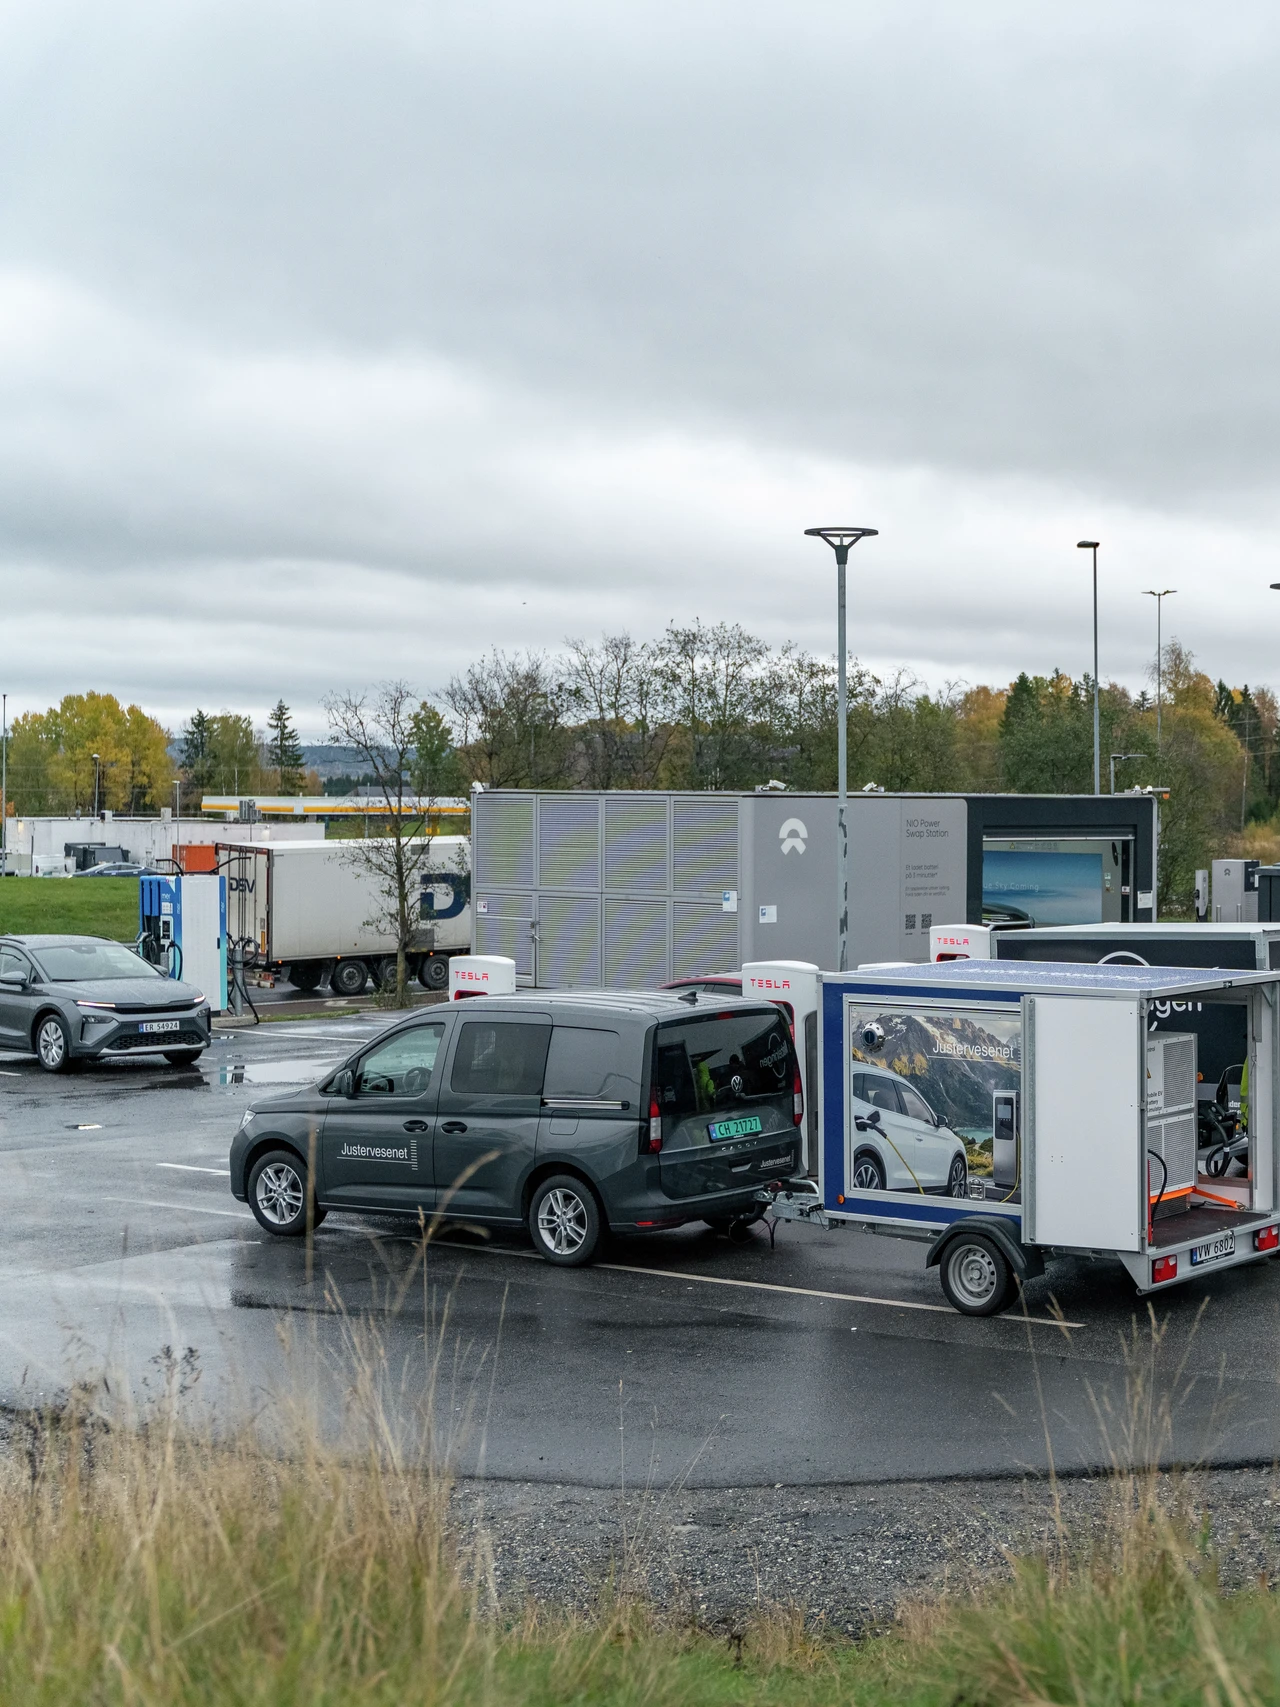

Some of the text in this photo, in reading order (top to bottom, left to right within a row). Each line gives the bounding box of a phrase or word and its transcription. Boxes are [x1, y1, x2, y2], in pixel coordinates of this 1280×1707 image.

[906, 819, 940, 828] NIO Power
[906, 829, 949, 839] Swap Station
[230, 877, 255, 893] DSV
[995, 882, 1007, 891] Sky
[1010, 883, 1039, 892] Coming
[937, 937, 969, 945] TESLA
[454, 970, 489, 981] TESLA
[750, 978, 790, 989] TESLA
[145, 1022, 178, 1031] ER 54924
[933, 1040, 1014, 1058] Justervesenet
[718, 1119, 758, 1136] CH 21727
[341, 1143, 408, 1159] Justervesenet
[760, 1155, 791, 1168] Justervesenet
[1198, 1242, 1211, 1259] VW
[1214, 1237, 1234, 1254] 6802
